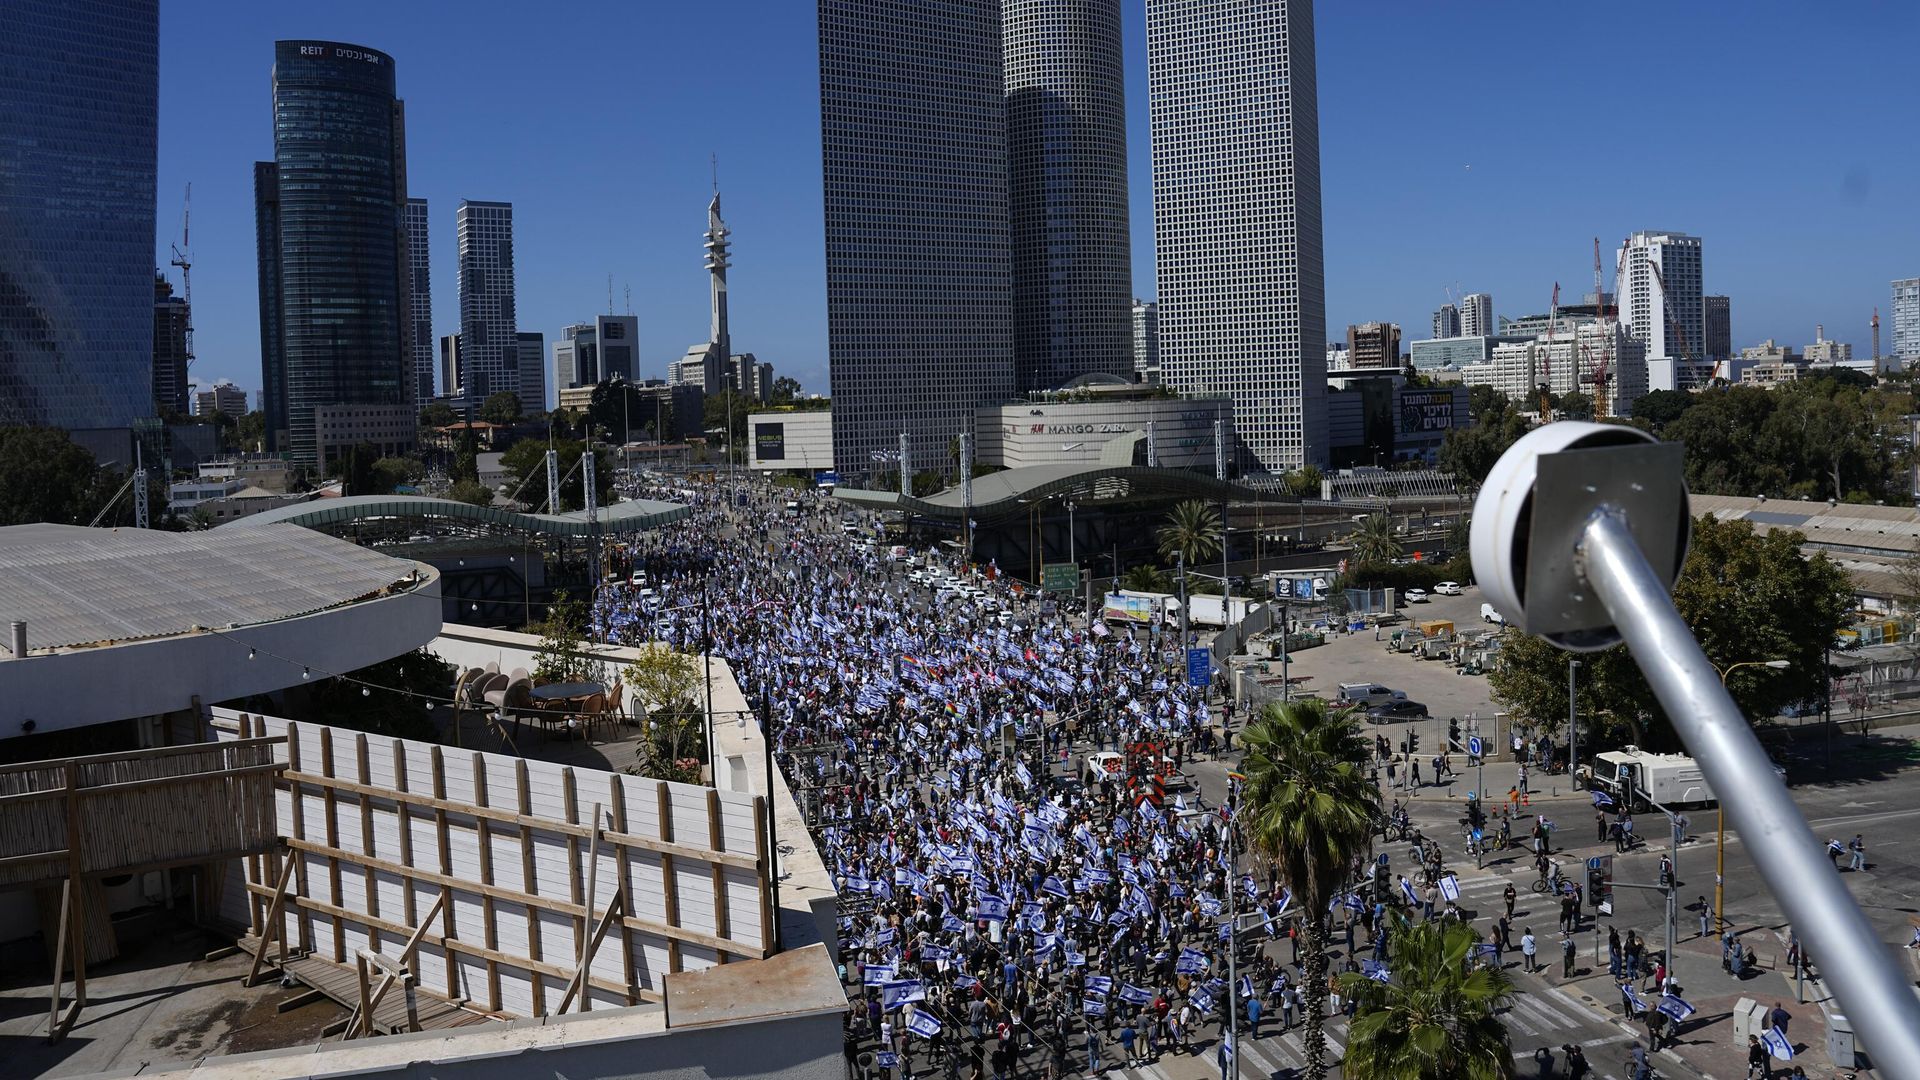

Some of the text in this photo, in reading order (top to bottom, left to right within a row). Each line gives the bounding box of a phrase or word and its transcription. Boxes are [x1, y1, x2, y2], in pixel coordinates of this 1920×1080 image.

[300, 46, 323, 55] REIT
[336, 48, 362, 60] נכסים
[1423, 403, 1451, 416] לדיכוי
[1423, 417, 1451, 428] נשים
[1048, 424, 1094, 434] MANGO
[1100, 424, 1128, 433] ZARA
